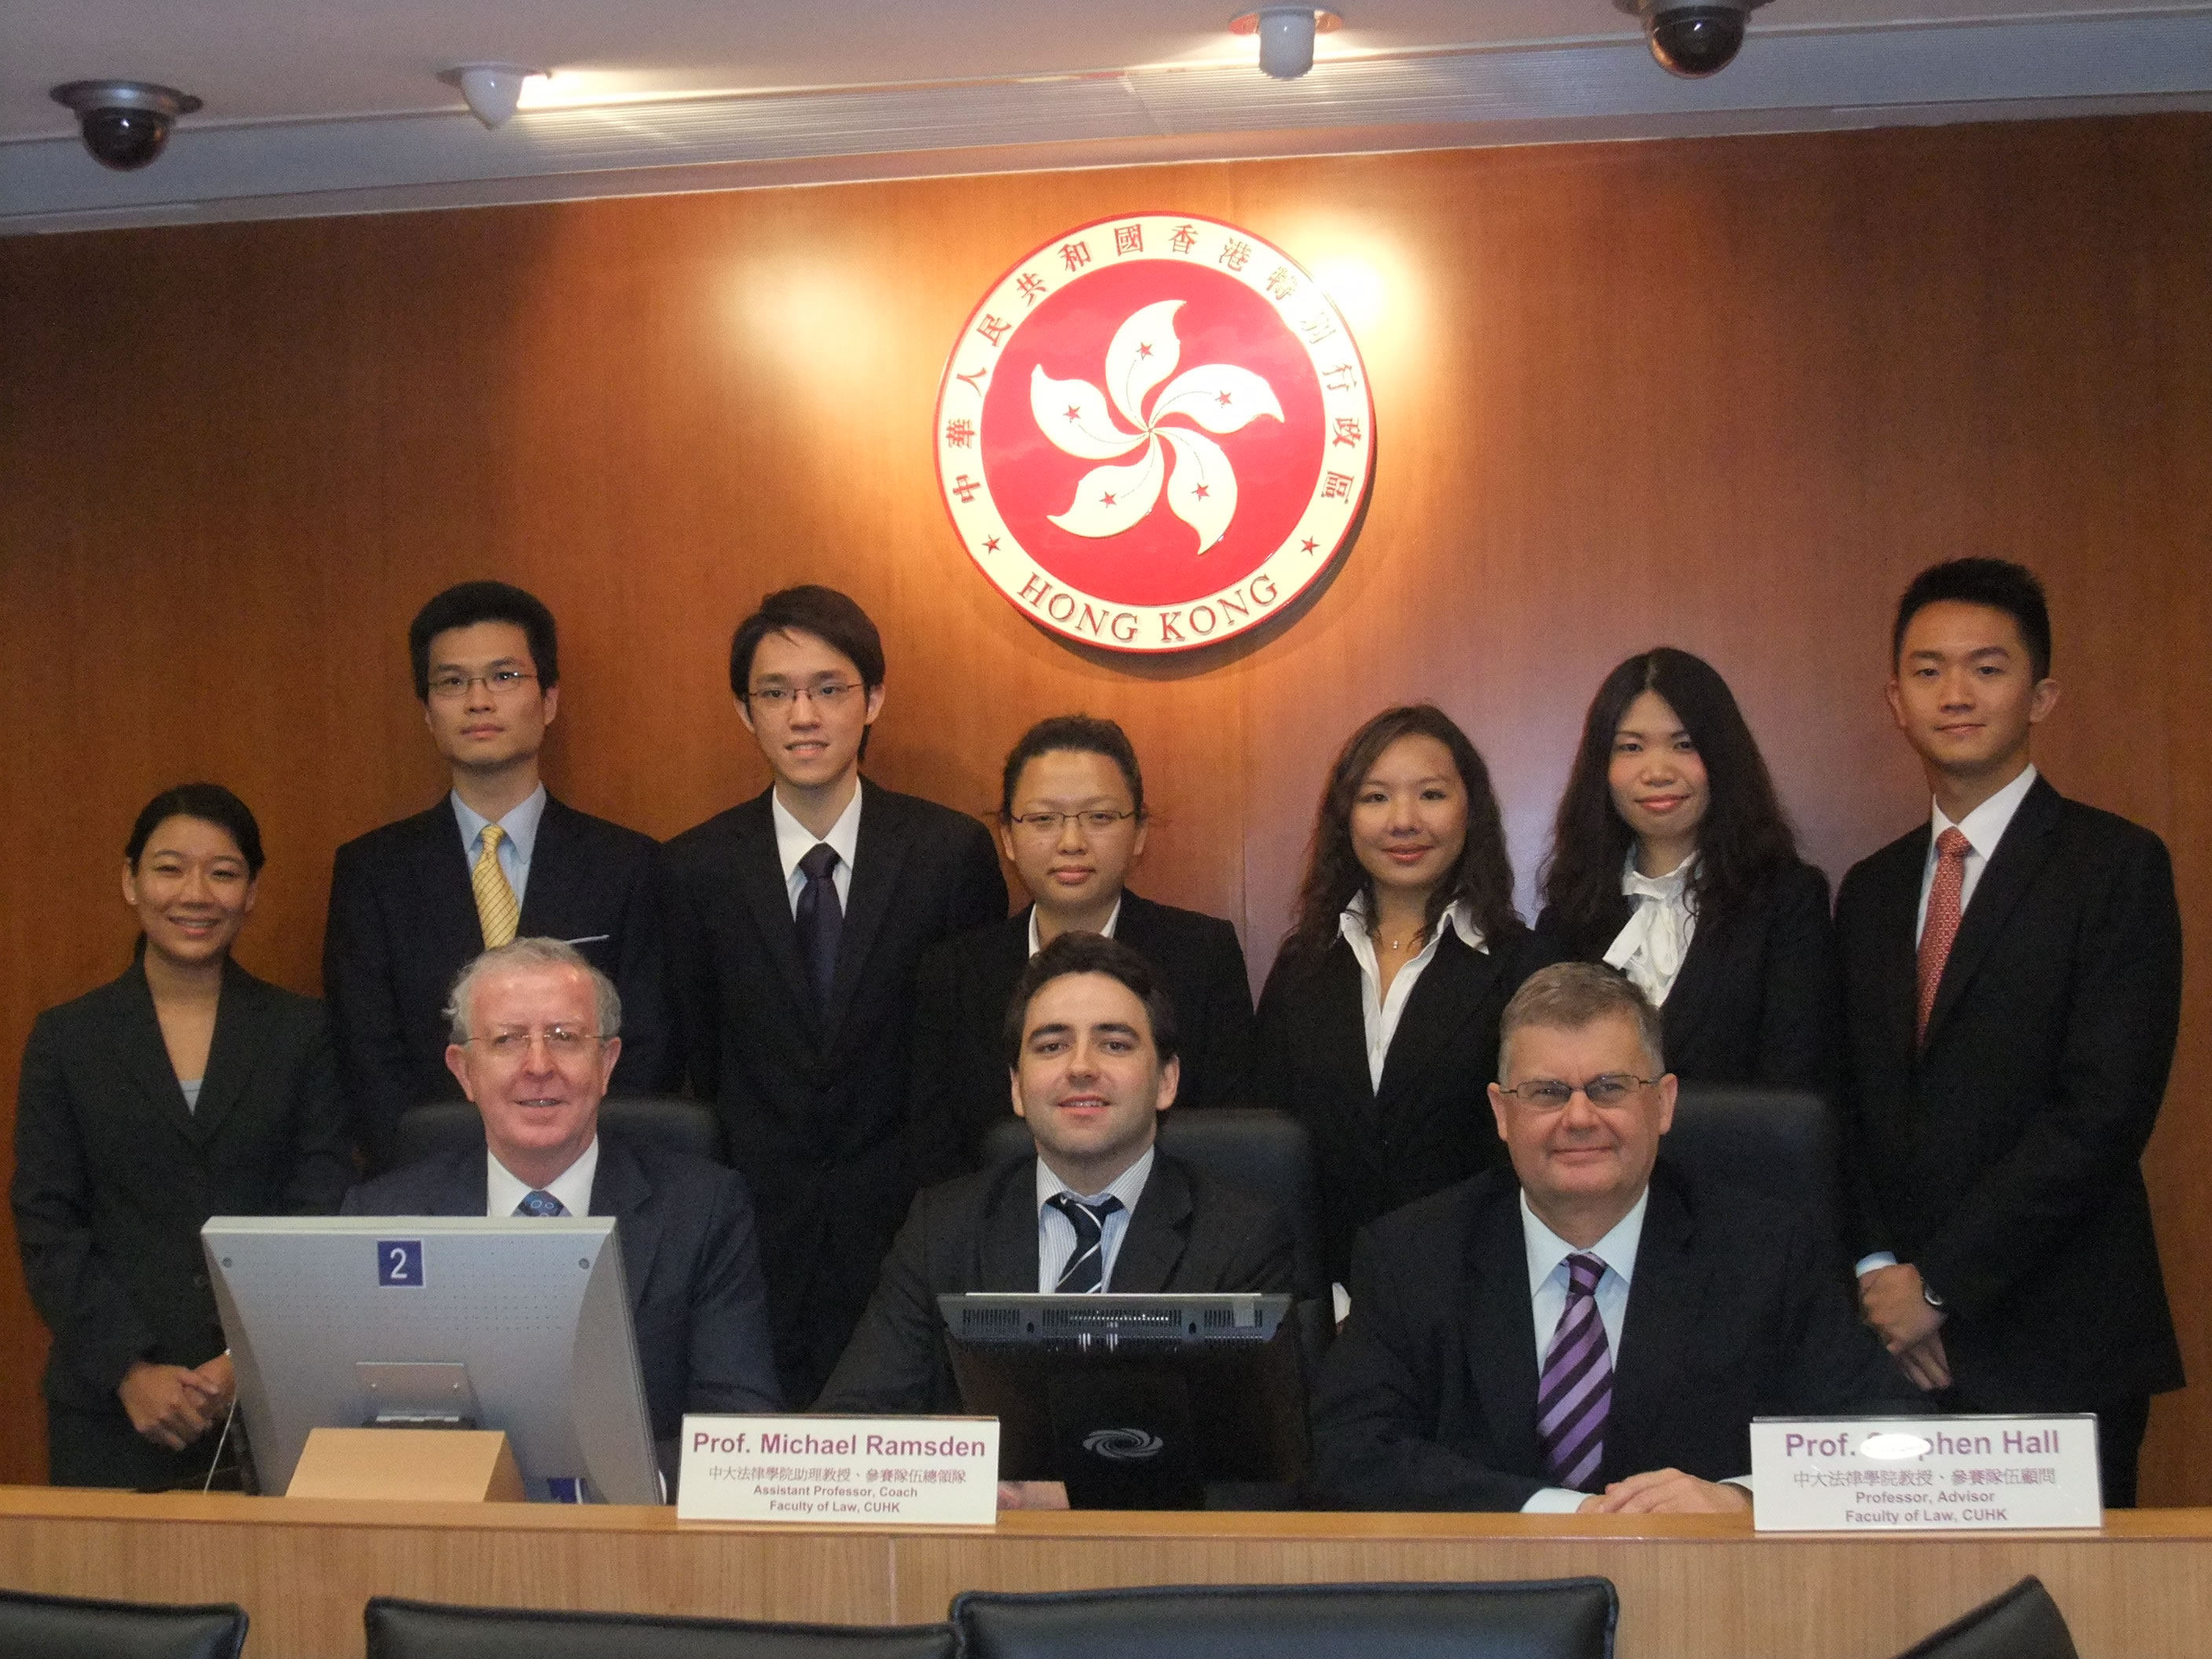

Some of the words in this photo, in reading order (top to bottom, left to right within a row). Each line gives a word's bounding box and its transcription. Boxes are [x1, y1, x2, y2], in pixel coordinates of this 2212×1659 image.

[945, 224, 1363, 507] 中華人民共和國香港特別行政區
[1016, 571, 1139, 643] HONG
[1160, 574, 1279, 643] KONG
[389, 1247, 408, 1279] 2
[693, 1433, 751, 1454] Prof.
[760, 1434, 856, 1456] Michael
[866, 1434, 987, 1457] Ramsden
[1785, 1433, 1856, 1457] Prof.
[2002, 1430, 2060, 1454] Hall
[753, 1484, 810, 1496] Assistant
[813, 1485, 876, 1499] Professor,
[879, 1487, 918, 1498] Coach
[1855, 1491, 1933, 1504] Professor,
[1937, 1490, 1995, 1503] Advisor
[770, 1500, 813, 1514] Faculty
[817, 1501, 830, 1513] of
[832, 1501, 861, 1514] Law,
[864, 1502, 900, 1514] CUHK
[1845, 1509, 1901, 1523] Faculty
[1904, 1510, 1920, 1522] of
[1923, 1510, 1957, 1523] Law,
[1962, 1509, 2008, 1522] CUHK
